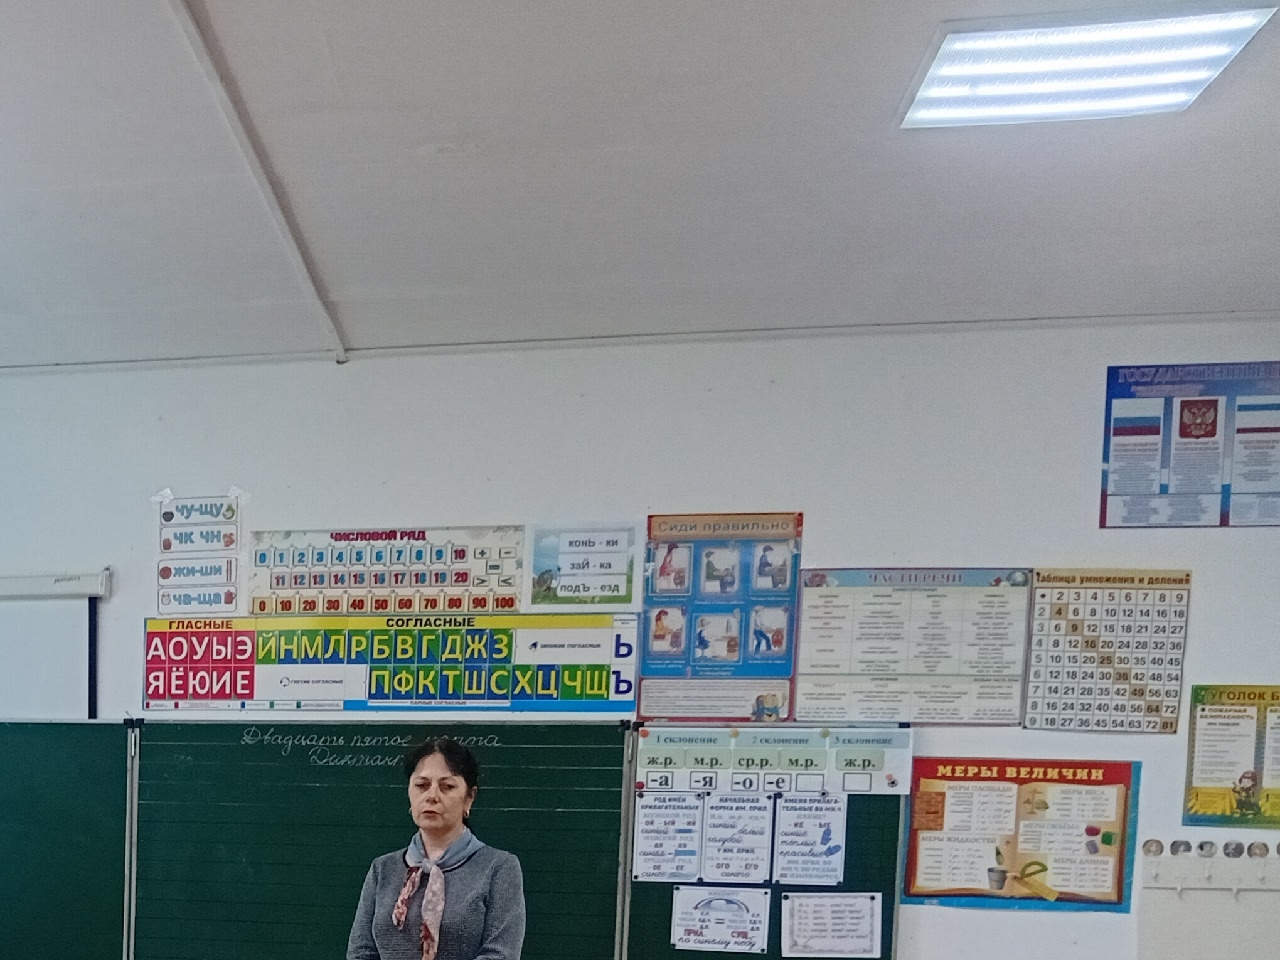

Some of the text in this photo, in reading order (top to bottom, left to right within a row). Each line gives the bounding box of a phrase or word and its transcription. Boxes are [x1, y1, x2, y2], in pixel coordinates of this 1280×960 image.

[659, 522, 789, 532] Сиди правильно
[330, 529, 427, 542] ЧИСЛОВОЙ РЯД
[259, 549, 466, 563] 0 1 2 3 4 5 6 7 8 9 10
[275, 572, 468, 585] 11 12 13 14 15 16 17 18 19 20
[1036, 573, 1190, 585] Таблица умножения и деления
[173, 593, 222, 608] ча-ща
[1057, 592, 1183, 602] 2 3 4 5 6 7 8 9
[259, 598, 514, 611] 0 10 20 30 40 50 60 70 80 90 100
[1038, 608, 1184, 618] 2 4 6 8 10 12 14 16 18
[169, 620, 233, 630] ГЛАСНЫЕ
[387, 617, 475, 628] СОГЛАСНЫЕ
[1037, 623, 1183, 634] 3 6 9 12 15 18 21 24 27
[615, 633, 633, 658] Ь
[1036, 639, 1042, 647] 4
[1053, 639, 1059, 647] 8
[1068, 640, 1079, 648] 12
[1085, 640, 1096, 648] 16
[1101, 640, 1113, 649] 20
[1118, 641, 1130, 649] 24
[1153, 642, 1165, 650] 32
[1170, 642, 1182, 650] 36
[612, 671, 633, 695] Ъ
[1211, 691, 1266, 700] УГОЛОК
[240, 726, 345, 756] Двадцать
[350, 734, 413, 747] пятое
[648, 756, 676, 767] ж.р.
[695, 757, 722, 767] м.р.
[738, 757, 772, 768] ср.р.
[788, 757, 818, 768] м.р.
[845, 757, 876, 768] ж.р.
[937, 765, 1104, 780] МЕРЫ ВЕЛИЧИН
